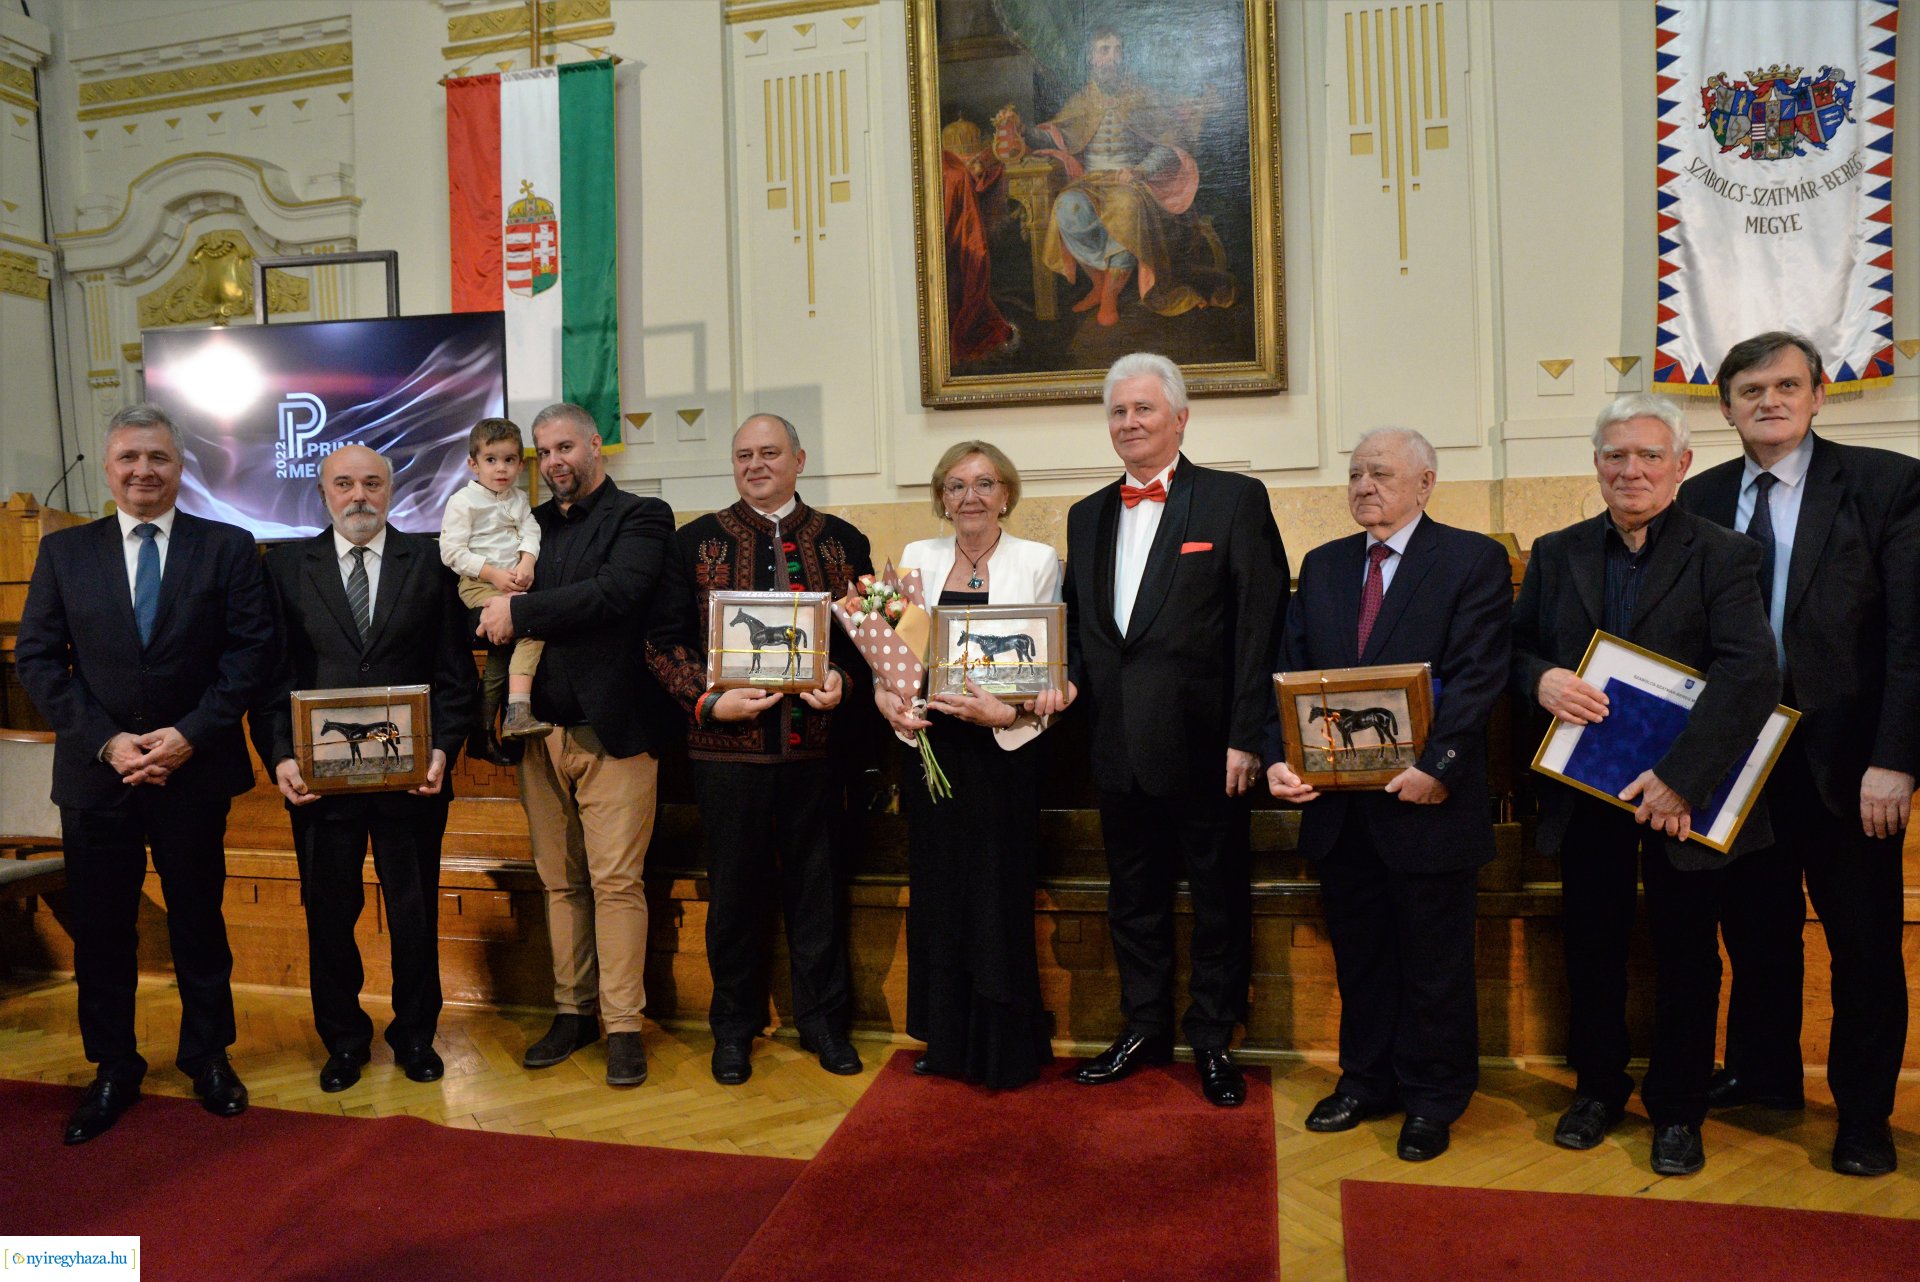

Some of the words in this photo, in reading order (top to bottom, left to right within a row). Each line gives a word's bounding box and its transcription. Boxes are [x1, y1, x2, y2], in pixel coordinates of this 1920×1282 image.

[1684, 152, 1863, 207] SZABOLCS-SZATMÁR-BEREG
[1745, 213, 1803, 235] MEGYE
[275, 441, 287, 479] 2022
[289, 463, 321, 478] ME
